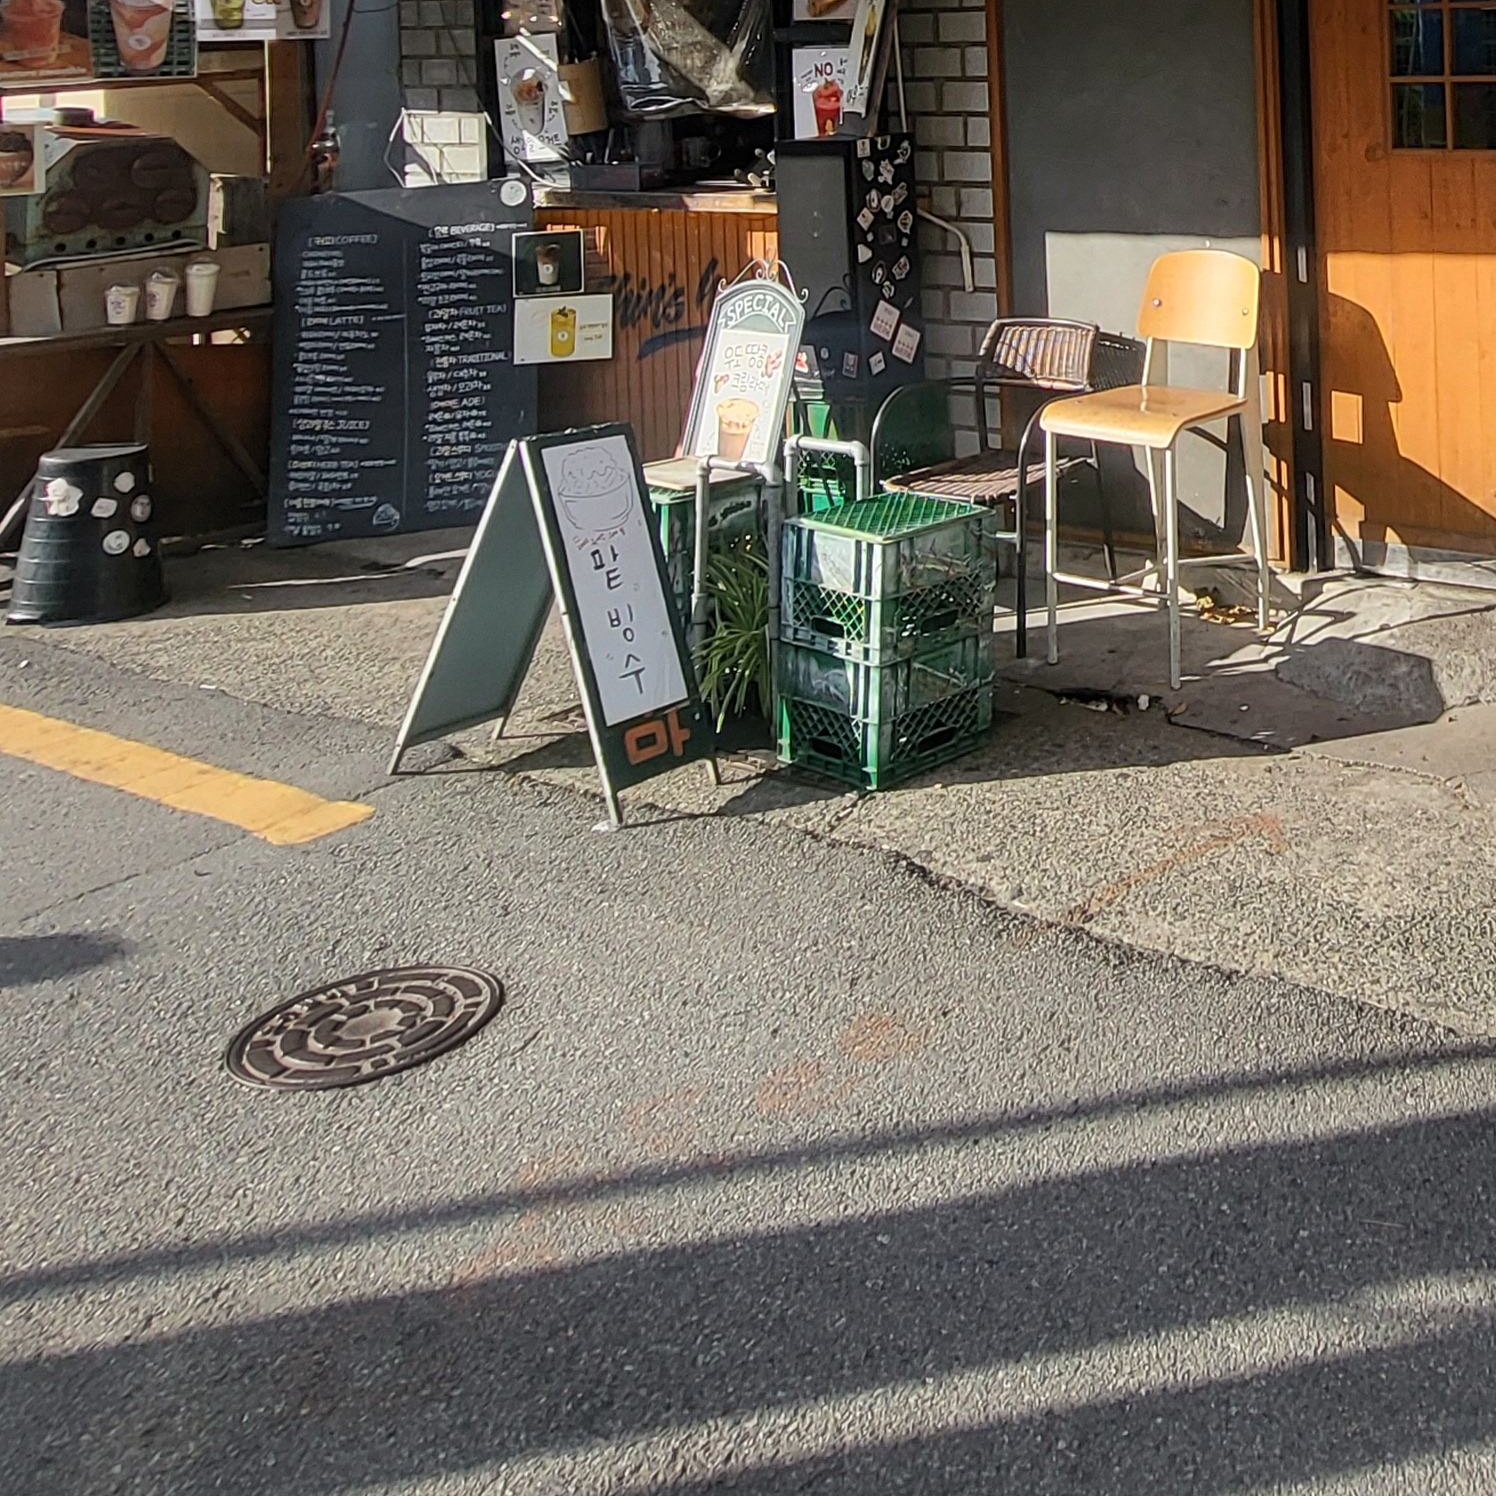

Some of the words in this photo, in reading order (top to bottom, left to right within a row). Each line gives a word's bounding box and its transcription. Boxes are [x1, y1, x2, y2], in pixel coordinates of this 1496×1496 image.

[814, 61, 833, 78] NO
[726, 293, 787, 328] SPECIAL
[745, 343, 769, 369] 땅콩
